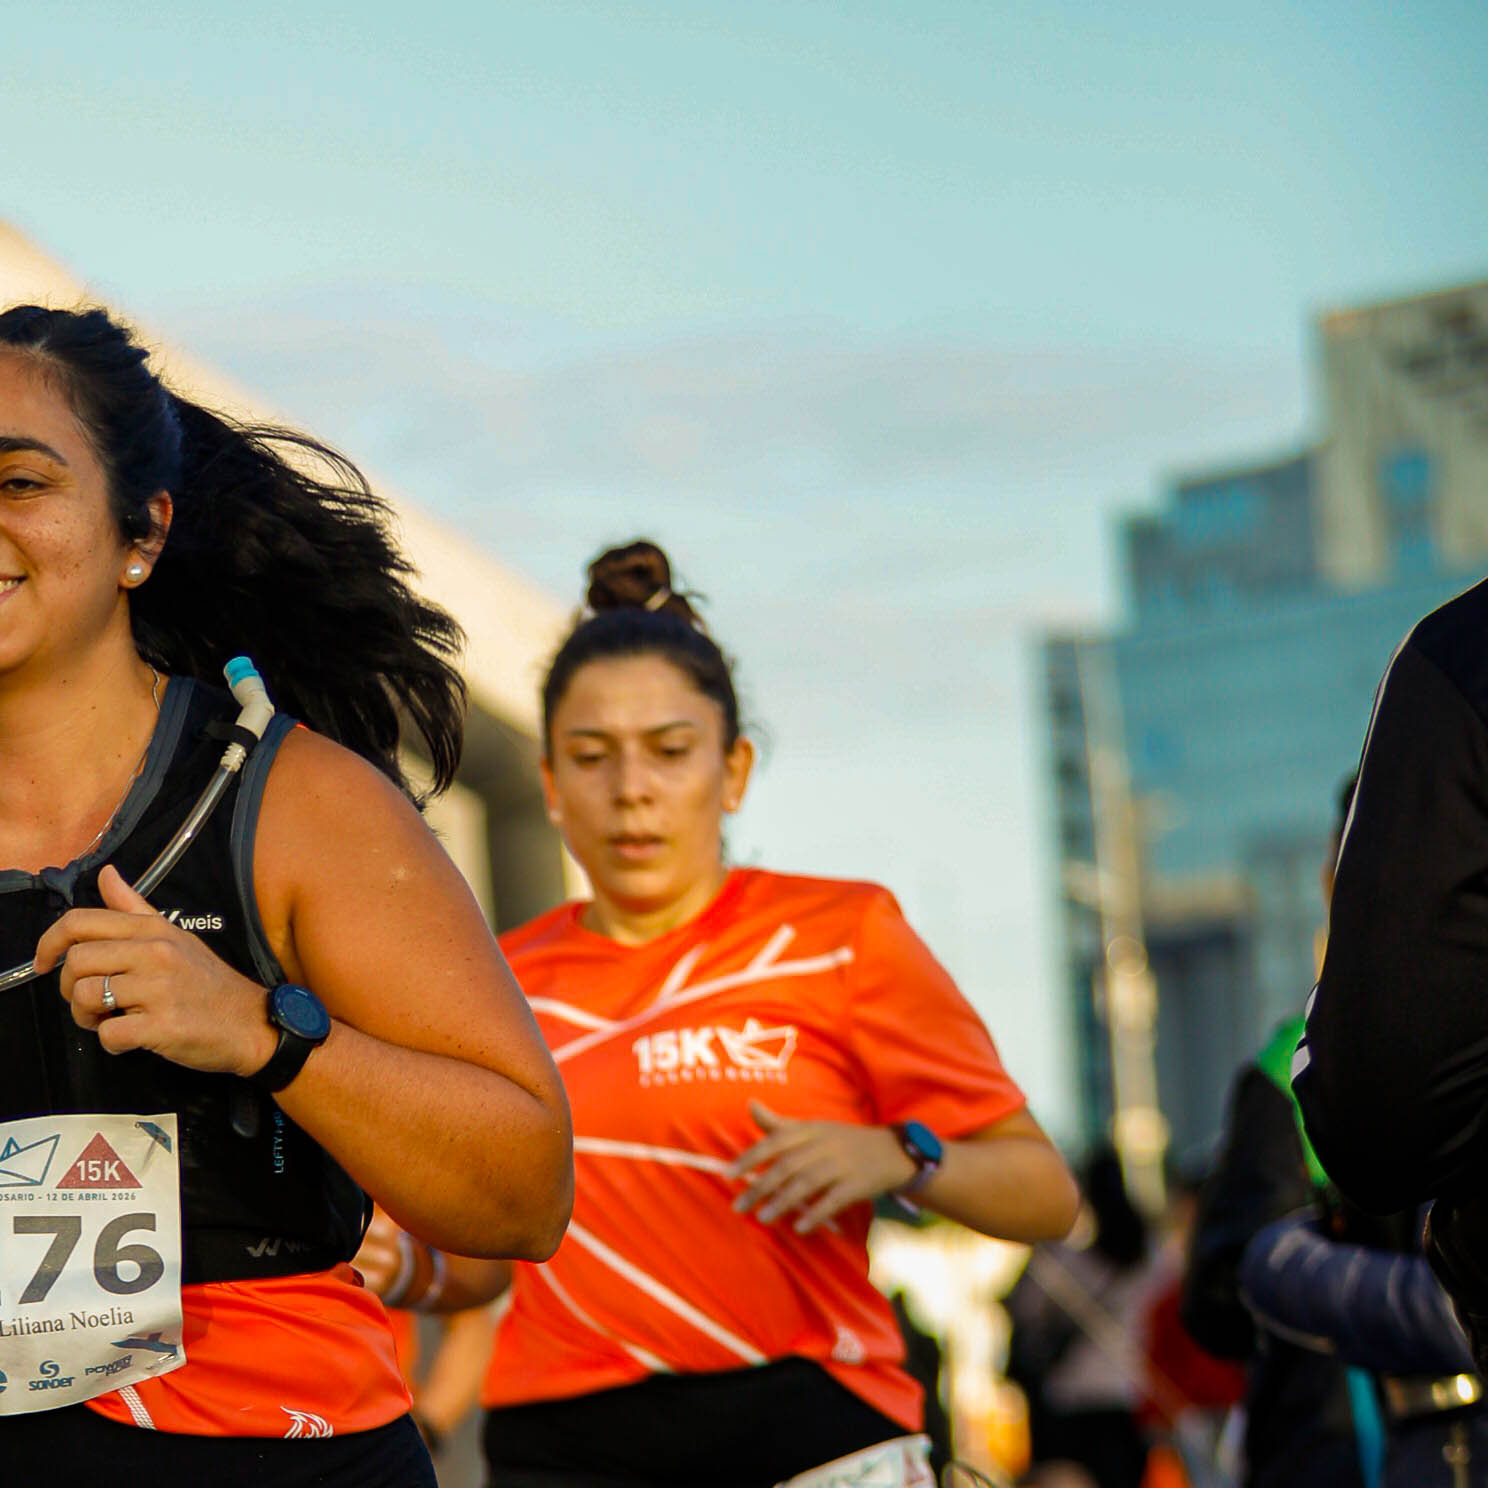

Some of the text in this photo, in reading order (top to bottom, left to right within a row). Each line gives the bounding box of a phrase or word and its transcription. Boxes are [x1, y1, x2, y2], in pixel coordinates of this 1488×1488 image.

[179, 914, 223, 930] weis
[632, 1026, 719, 1072] 15K
[76, 1160, 121, 1182] 15K
[47, 1193, 57, 1201] 12
[62, 1193, 74, 1201] DE
[78, 1193, 108, 1201] ABRIL
[112, 1193, 136, 1201] 2026
[71, 1307, 134, 1329] Noelia
